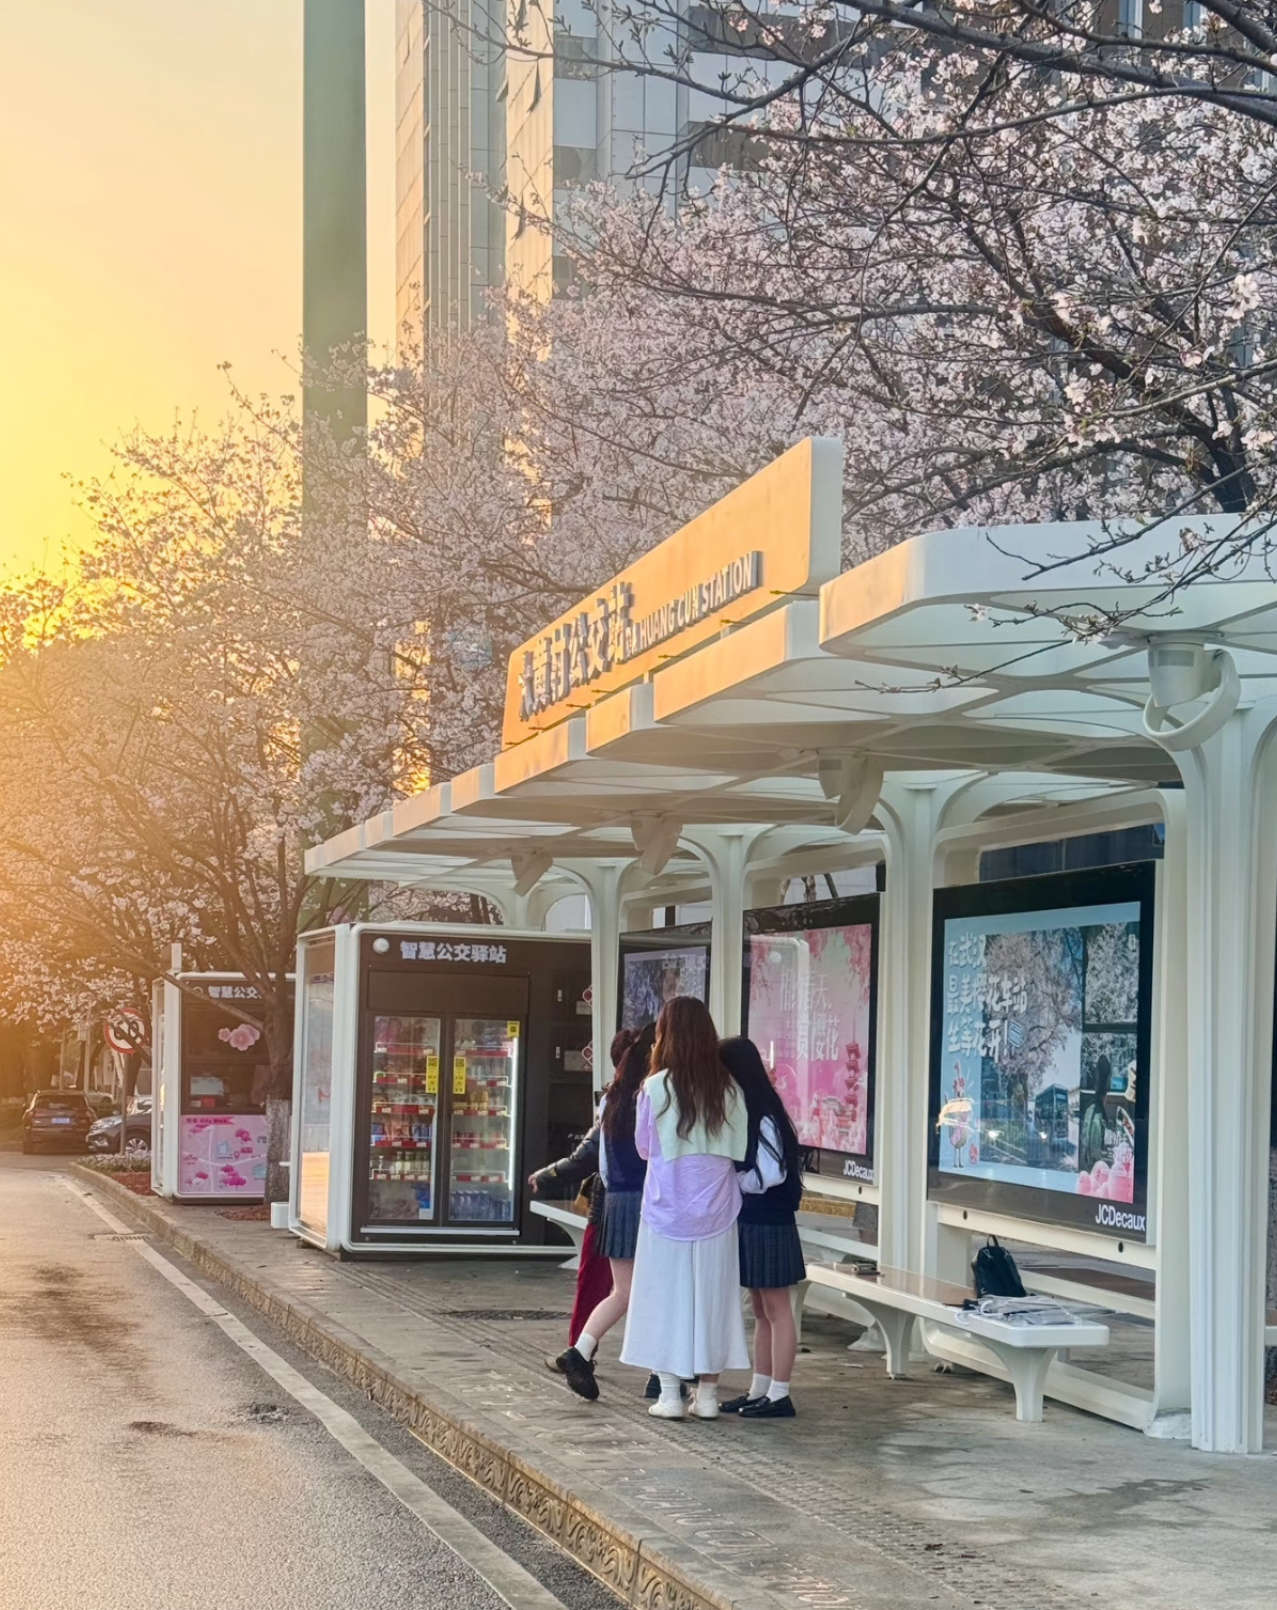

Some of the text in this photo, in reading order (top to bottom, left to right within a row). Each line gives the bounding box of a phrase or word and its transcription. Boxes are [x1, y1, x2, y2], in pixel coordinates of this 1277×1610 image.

[639, 599, 678, 650] HUANG
[677, 583, 704, 628] CUN
[701, 550, 761, 612] STATION
[400, 941, 507, 963] 智慧公交驿站
[948, 931, 986, 969] 在武汉
[947, 973, 1027, 1014] 最美樱花车站
[843, 1160, 875, 1180] JCDecau
[1095, 1204, 1146, 1231] JCDecaux
